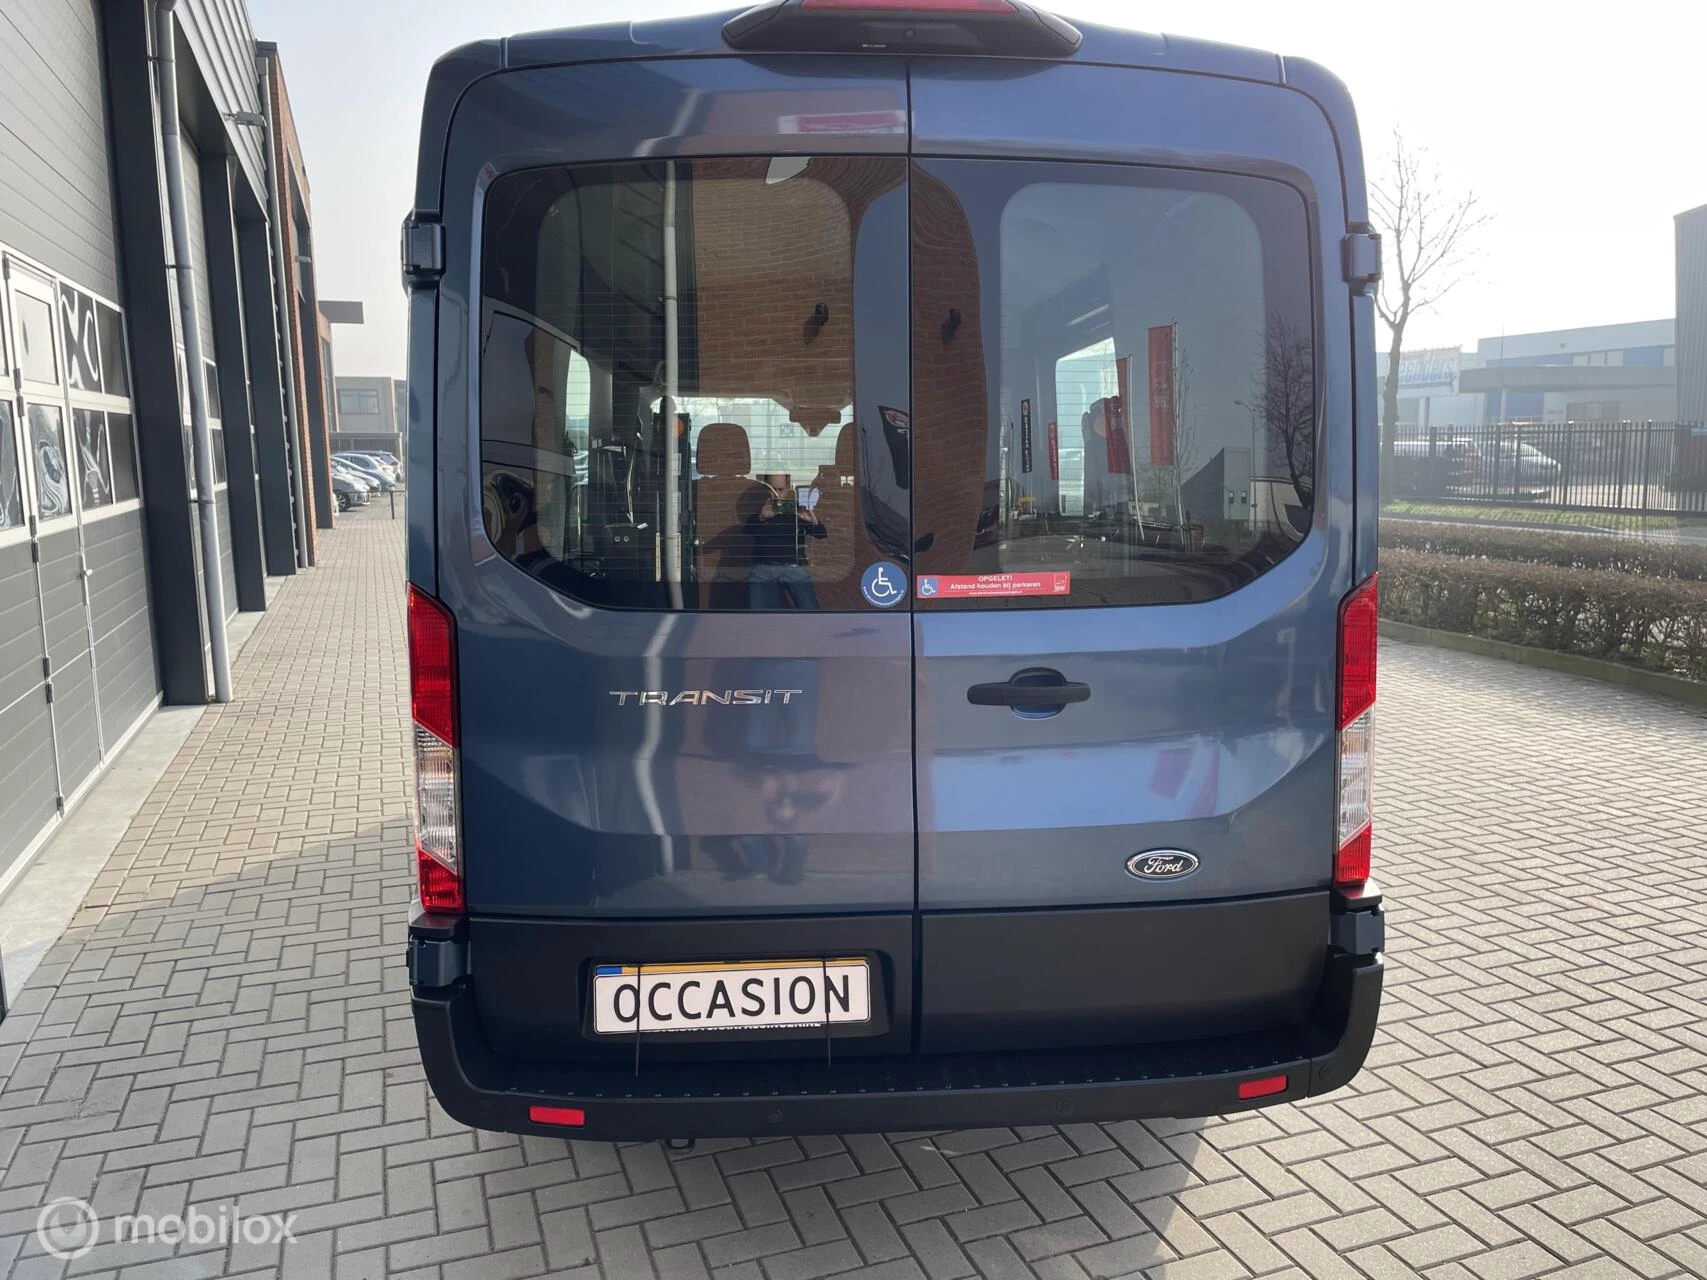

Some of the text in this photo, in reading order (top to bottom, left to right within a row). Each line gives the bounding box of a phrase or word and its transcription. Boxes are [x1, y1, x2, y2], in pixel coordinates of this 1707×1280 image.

[976, 582, 1002, 590] houden
[1002, 582, 1011, 590] bij
[1012, 581, 1041, 589] parkeren
[609, 689, 803, 706] TRANSIT
[1143, 856, 1184, 874] Ford
[613, 974, 850, 1023] OCCASION
